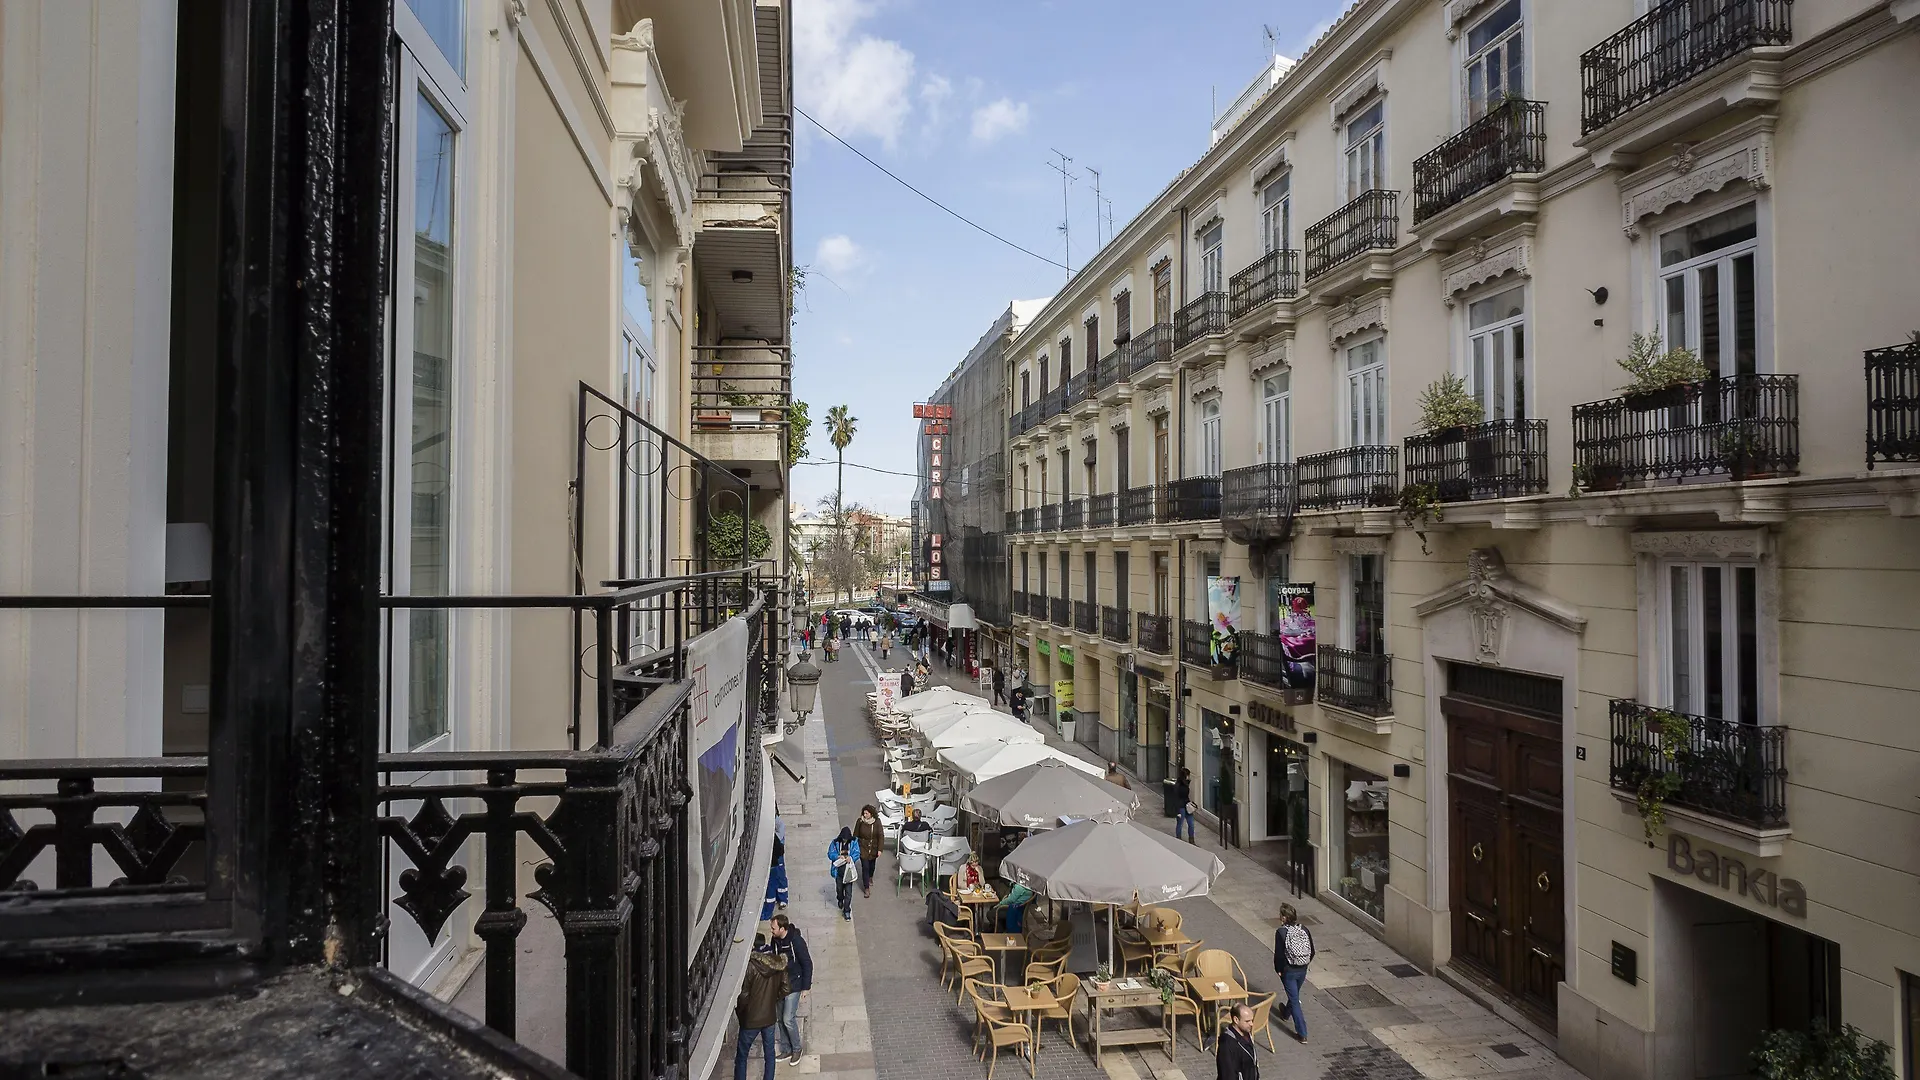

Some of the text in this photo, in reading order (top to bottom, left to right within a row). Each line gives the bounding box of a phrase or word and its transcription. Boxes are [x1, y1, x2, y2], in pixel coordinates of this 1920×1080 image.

[1281, 587, 1311, 595] GOYBAL
[1247, 700, 1298, 734] GOYBAL
[1578, 748, 1584, 759] 2
[1668, 833, 1808, 919] Bankia
